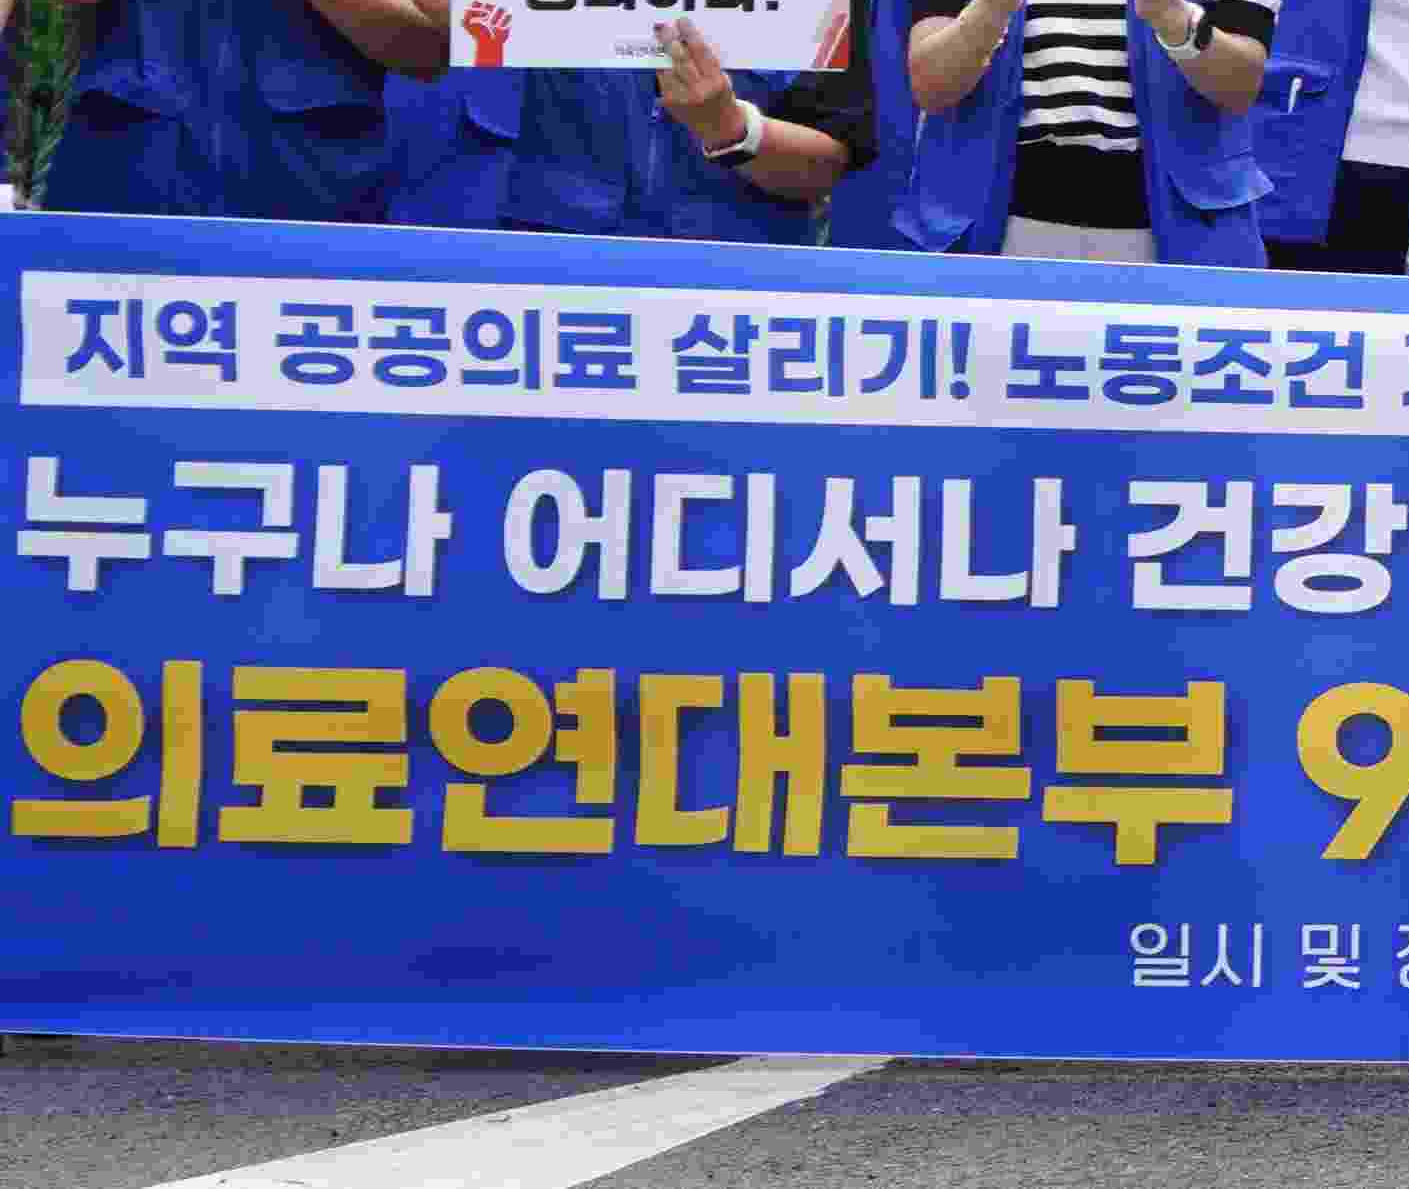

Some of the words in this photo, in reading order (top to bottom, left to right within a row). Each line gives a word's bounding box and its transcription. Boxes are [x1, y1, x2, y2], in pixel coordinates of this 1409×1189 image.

[66, 298, 238, 382] 지역
[275, 302, 638, 392] 공공의료
[670, 313, 971, 402] 살리기!
[1005, 321, 1366, 410] 노동조건
[17, 455, 452, 596] 누구나
[502, 467, 1076, 608] 어디서나
[10, 658, 1234, 865] 의료연대본부
[1129, 923, 1264, 988] 일시
[1301, 923, 1360, 989] 및
